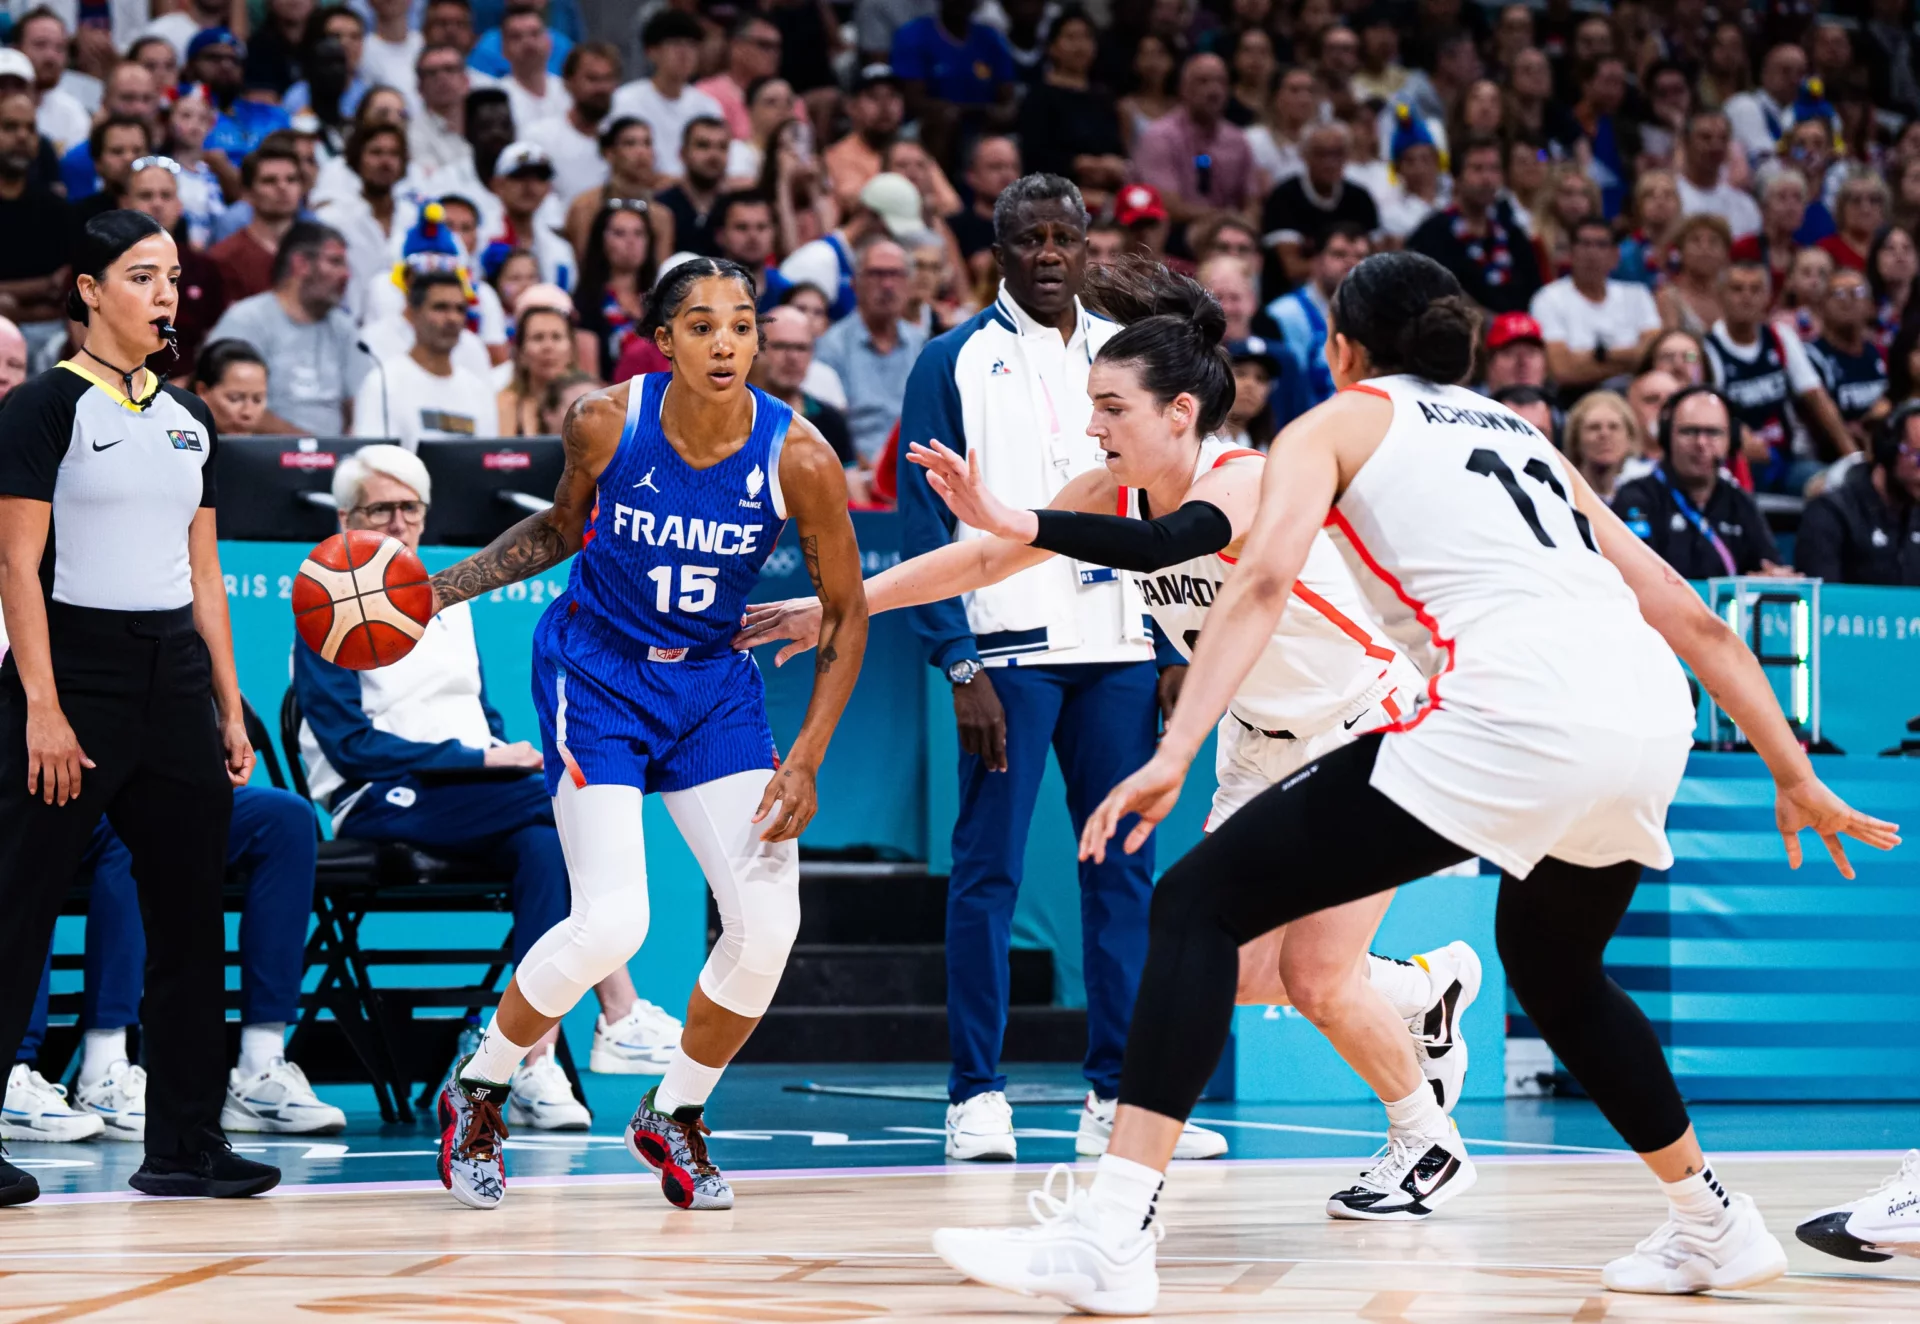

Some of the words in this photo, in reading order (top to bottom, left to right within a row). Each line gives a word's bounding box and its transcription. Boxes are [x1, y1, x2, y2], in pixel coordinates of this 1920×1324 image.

[739, 499, 762, 509] FRANCE
[1466, 448, 1602, 555] 11
[614, 503, 763, 555] FRANCE
[647, 565, 719, 613] 15
